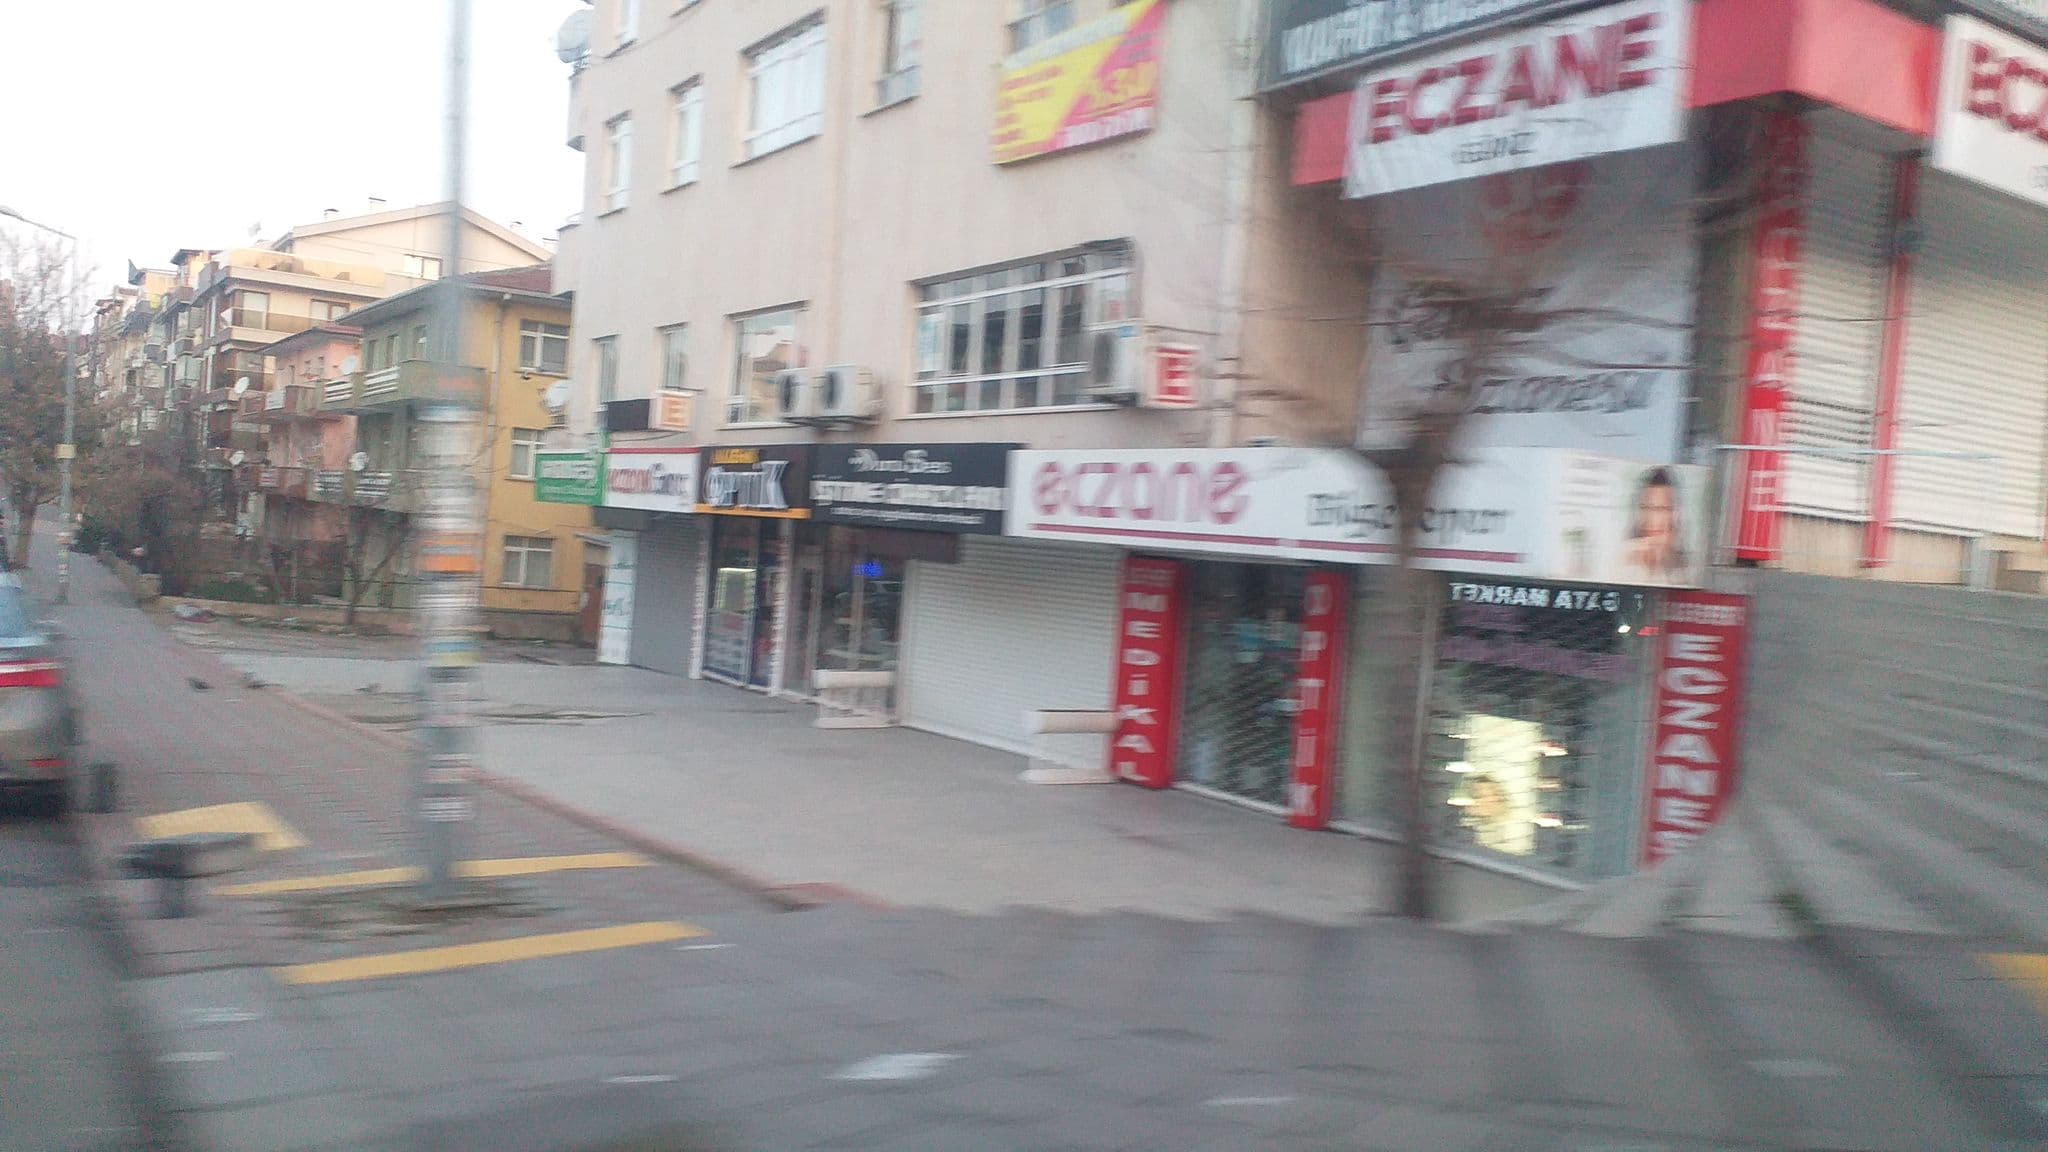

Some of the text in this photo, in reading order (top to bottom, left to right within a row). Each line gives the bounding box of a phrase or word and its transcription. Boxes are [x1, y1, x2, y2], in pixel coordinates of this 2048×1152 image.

[1368, 14, 1657, 143] ECZANE
[1032, 461, 1249, 524] eczane
[1114, 592, 1167, 781] MEDİKAL
